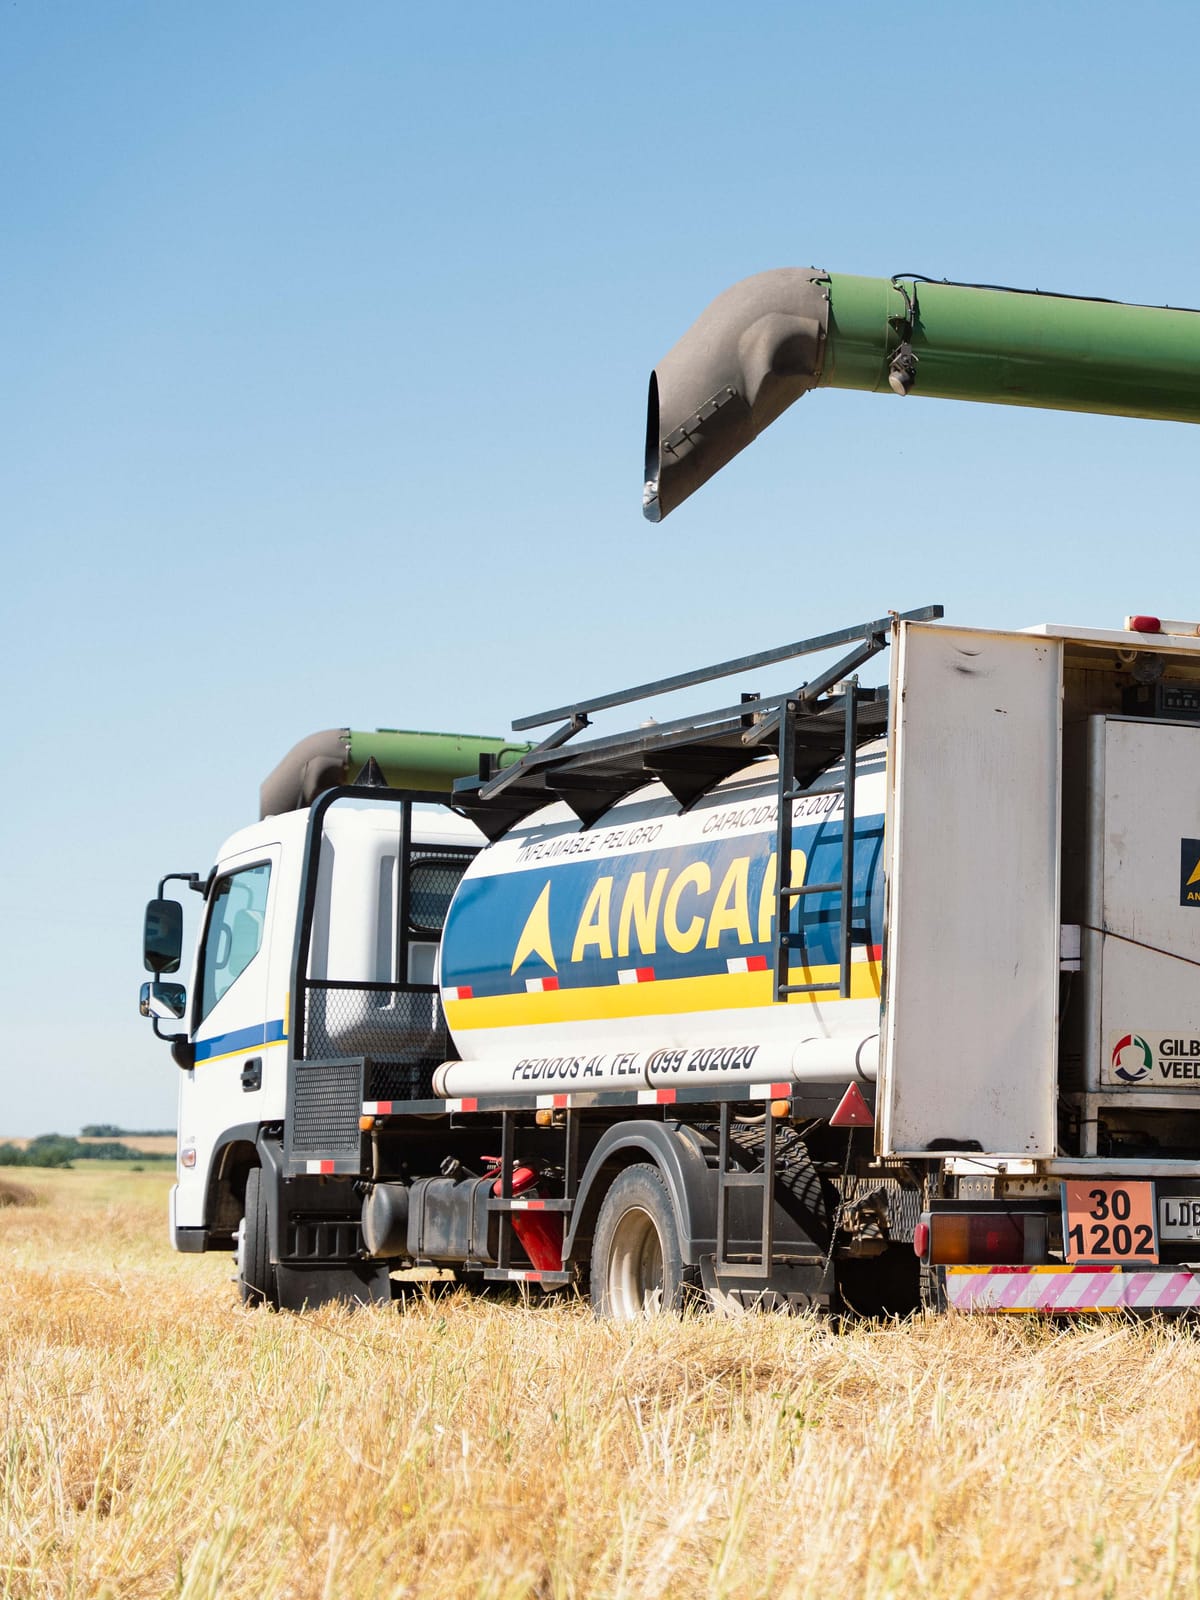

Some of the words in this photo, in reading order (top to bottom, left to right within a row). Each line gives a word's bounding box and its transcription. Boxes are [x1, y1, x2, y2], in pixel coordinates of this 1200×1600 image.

[702, 804, 779, 834] CAPACIDA
[515, 836, 601, 863] INFLAMABLE
[600, 824, 663, 849] PELIGRO
[570, 849, 807, 963] ANCAP
[512, 1056, 585, 1080] PEDIDOS
[583, 1054, 607, 1078] AL
[610, 1052, 641, 1075] TEL.
[650, 1048, 688, 1074] 099
[687, 1045, 760, 1072] 202020
[1088, 1189, 1131, 1221] 30
[1068, 1224, 1155, 1255] 1202
